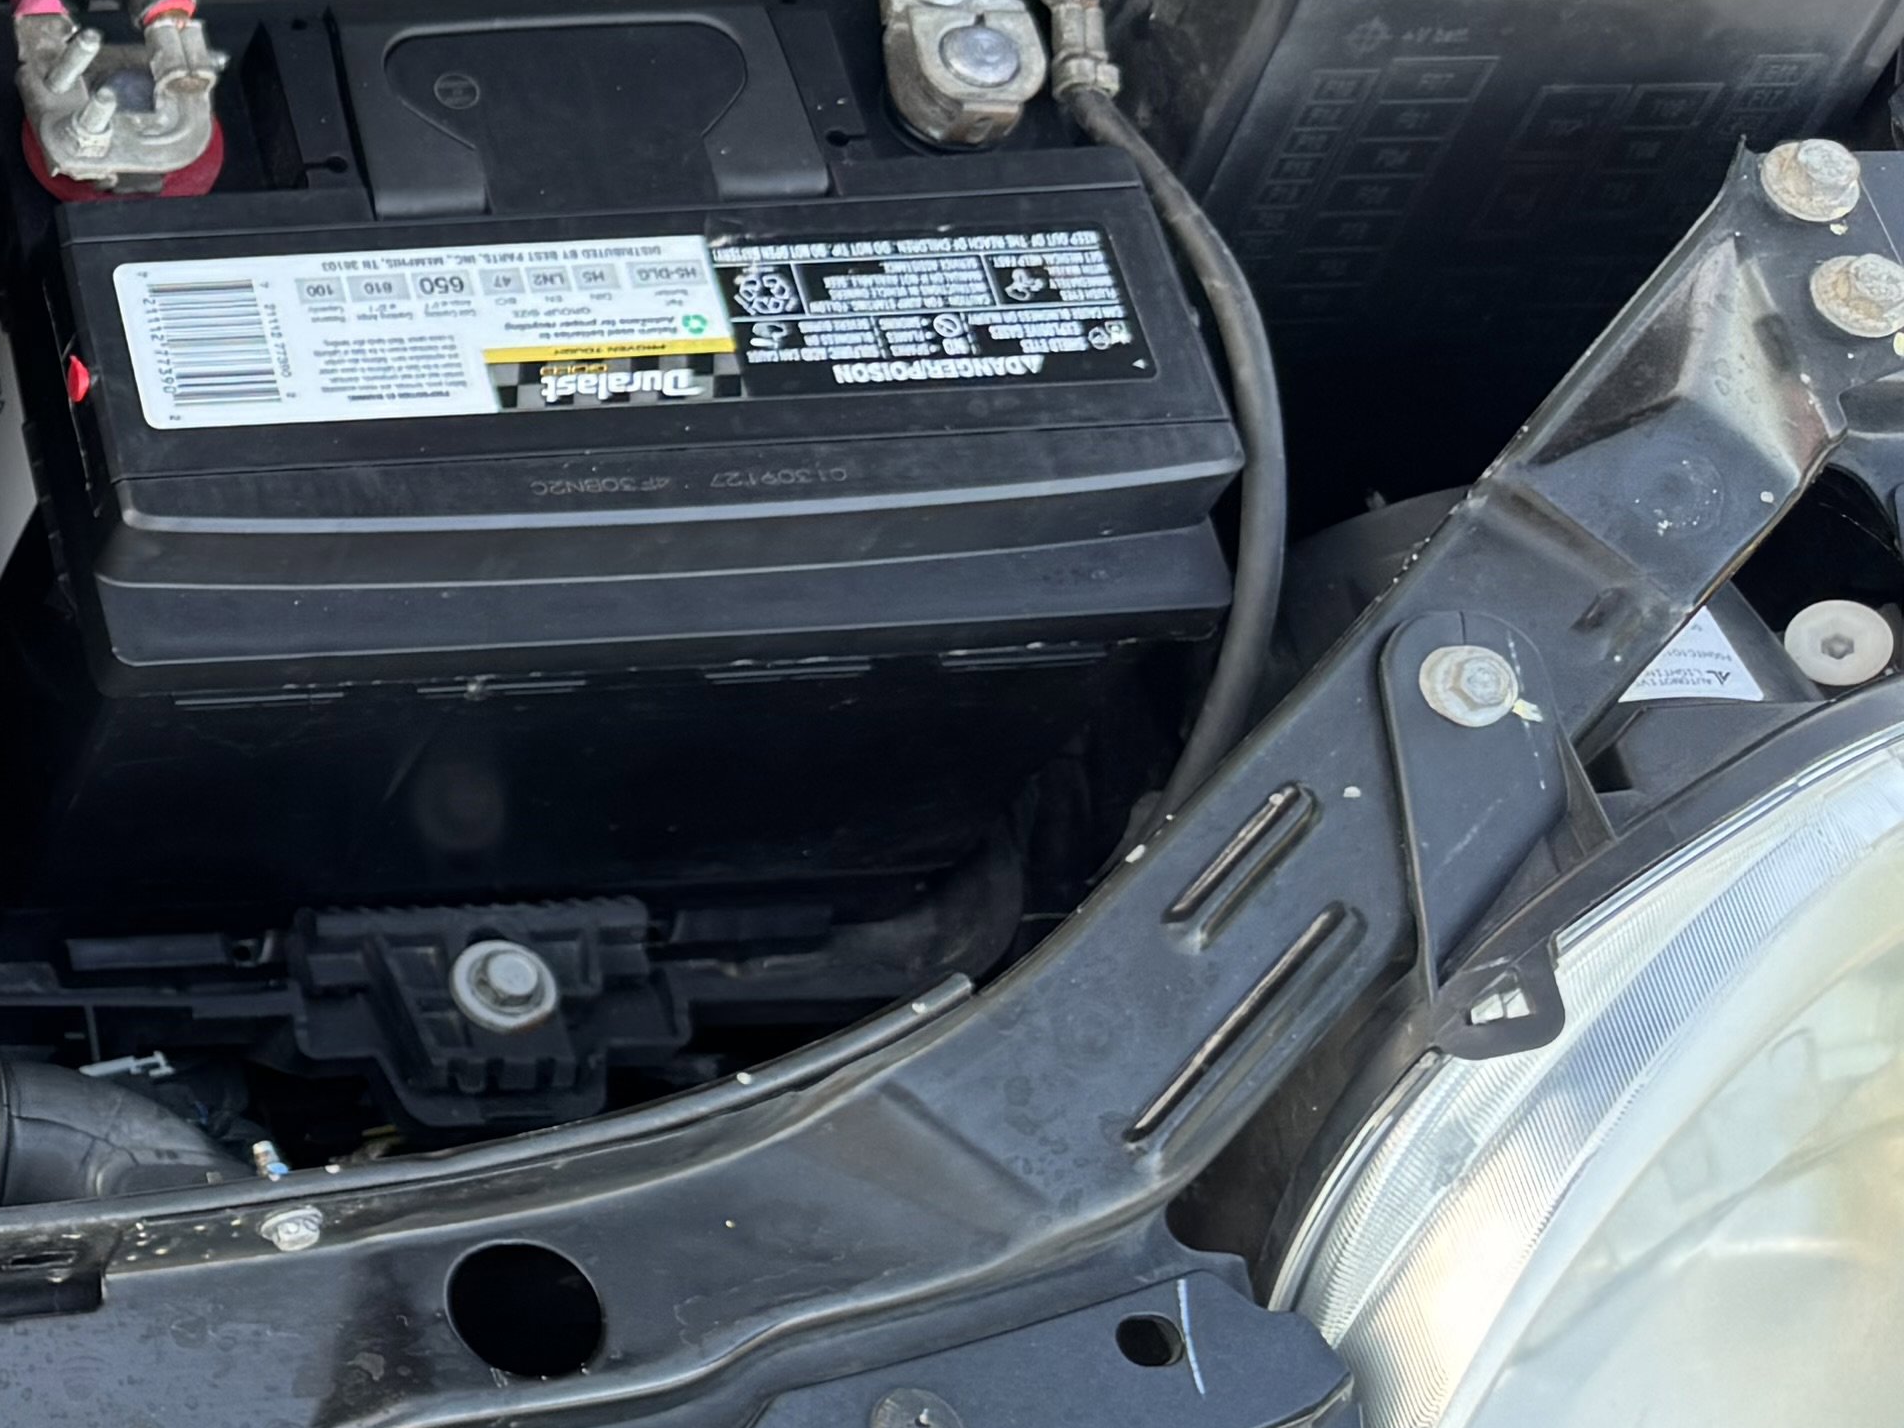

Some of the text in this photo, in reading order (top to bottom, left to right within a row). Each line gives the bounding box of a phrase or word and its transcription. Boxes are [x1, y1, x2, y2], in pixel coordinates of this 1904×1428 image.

[528, 250, 558, 260] BEST
[562, 249, 578, 259] BY
[582, 245, 661, 258] DISTRIBUTED
[418, 275, 465, 296] 650
[493, 275, 513, 287] 47
[306, 284, 334, 297] 100
[513, 307, 591, 318] GROUP SIZE
[155, 349, 177, 394] 77390
[832, 354, 1028, 384] DANGER/POISON
[540, 368, 703, 403] Duralast
